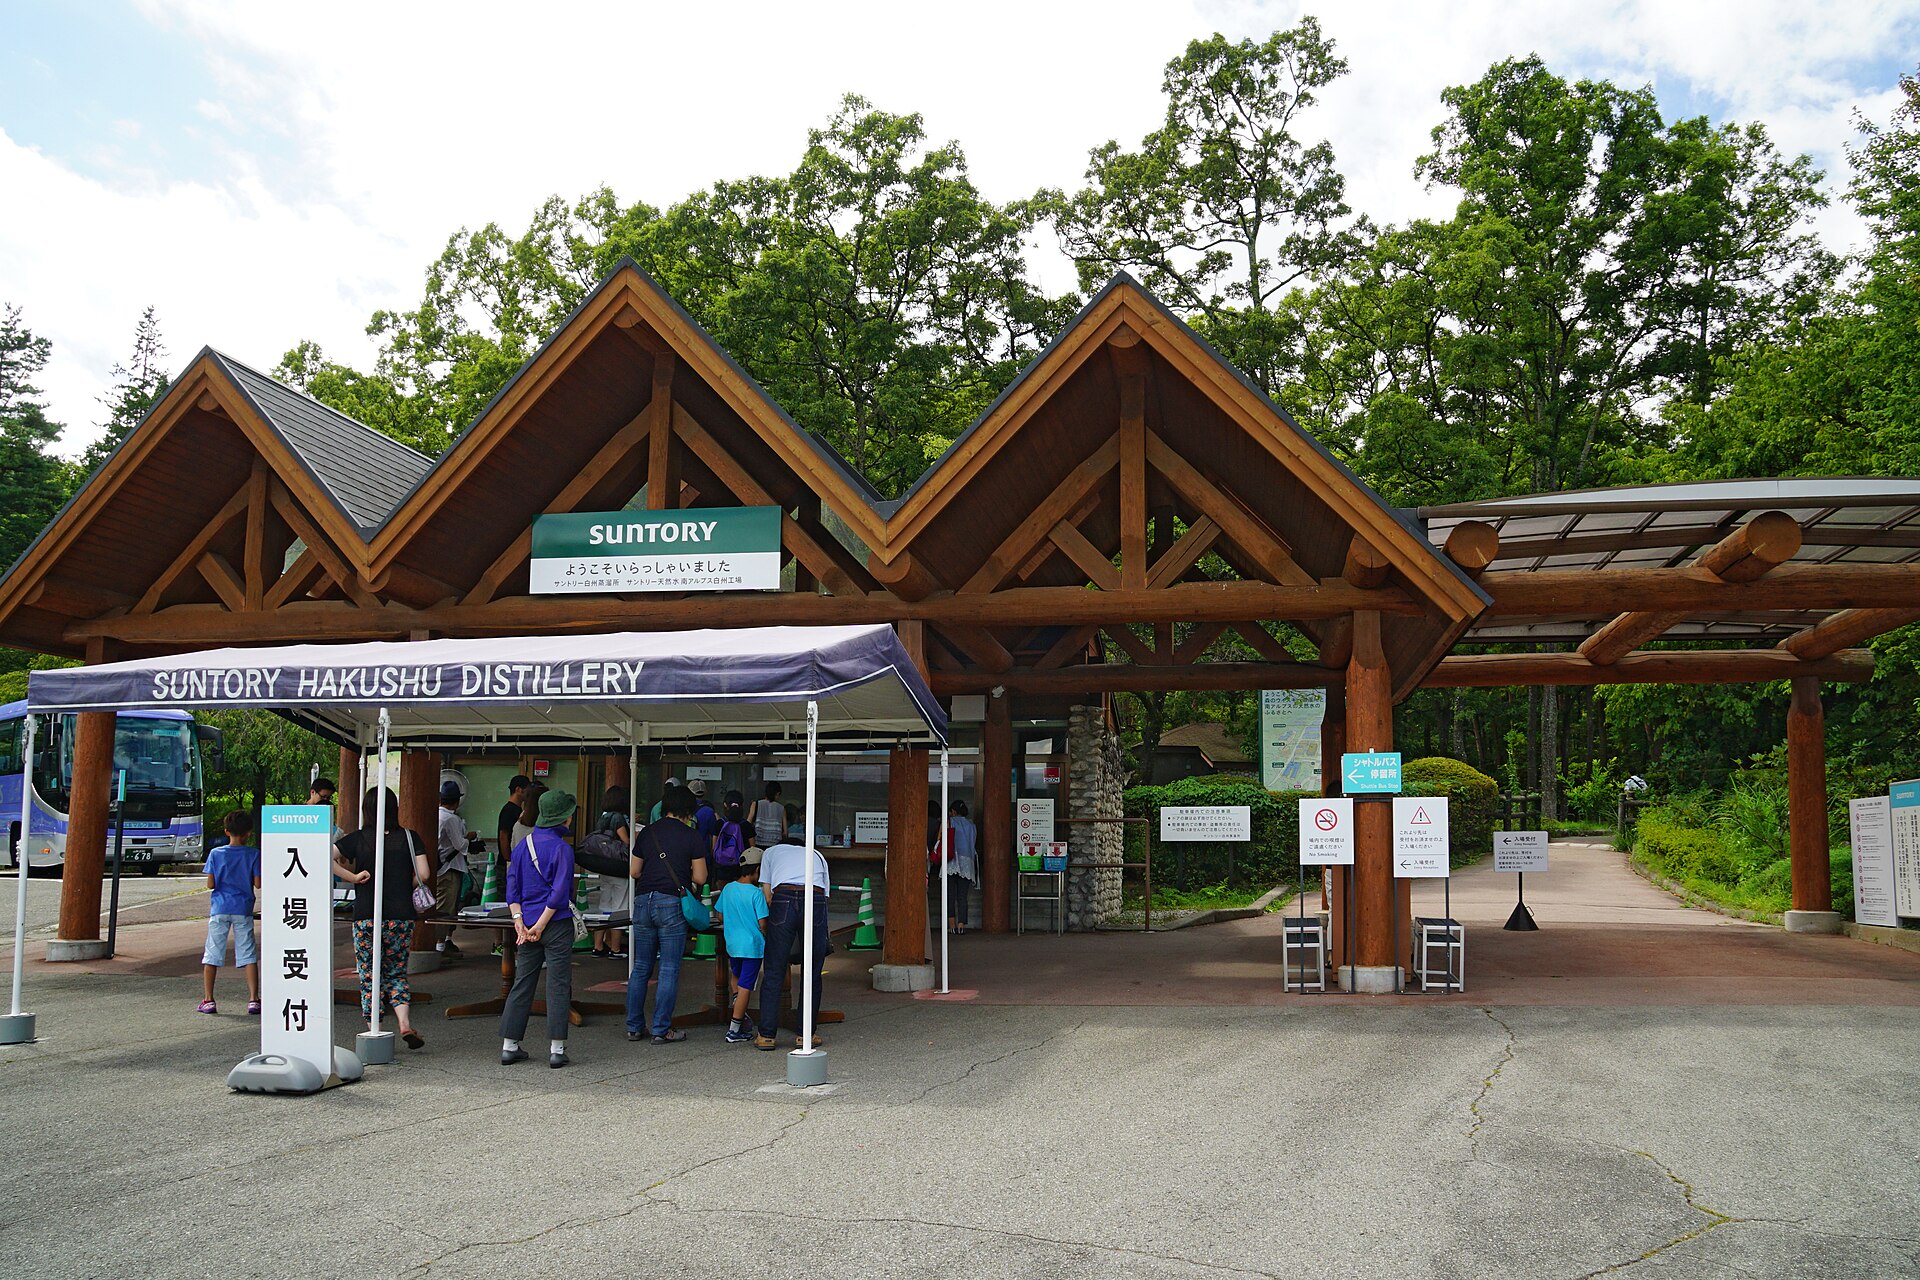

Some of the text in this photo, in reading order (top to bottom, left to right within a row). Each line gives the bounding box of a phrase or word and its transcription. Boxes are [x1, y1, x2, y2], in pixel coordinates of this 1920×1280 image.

[589, 521, 718, 545] SUNTORY
[565, 559, 731, 576] ようこそいらっしゃいました
[152, 660, 645, 700] SUNTORY HAKUSHU DISTILLERY
[1353, 757, 1397, 767] シャトルバス
[1370, 769, 1397, 779] 停留所
[271, 814, 320, 824] SUNTORY
[282, 847, 309, 1032] 入場受付
